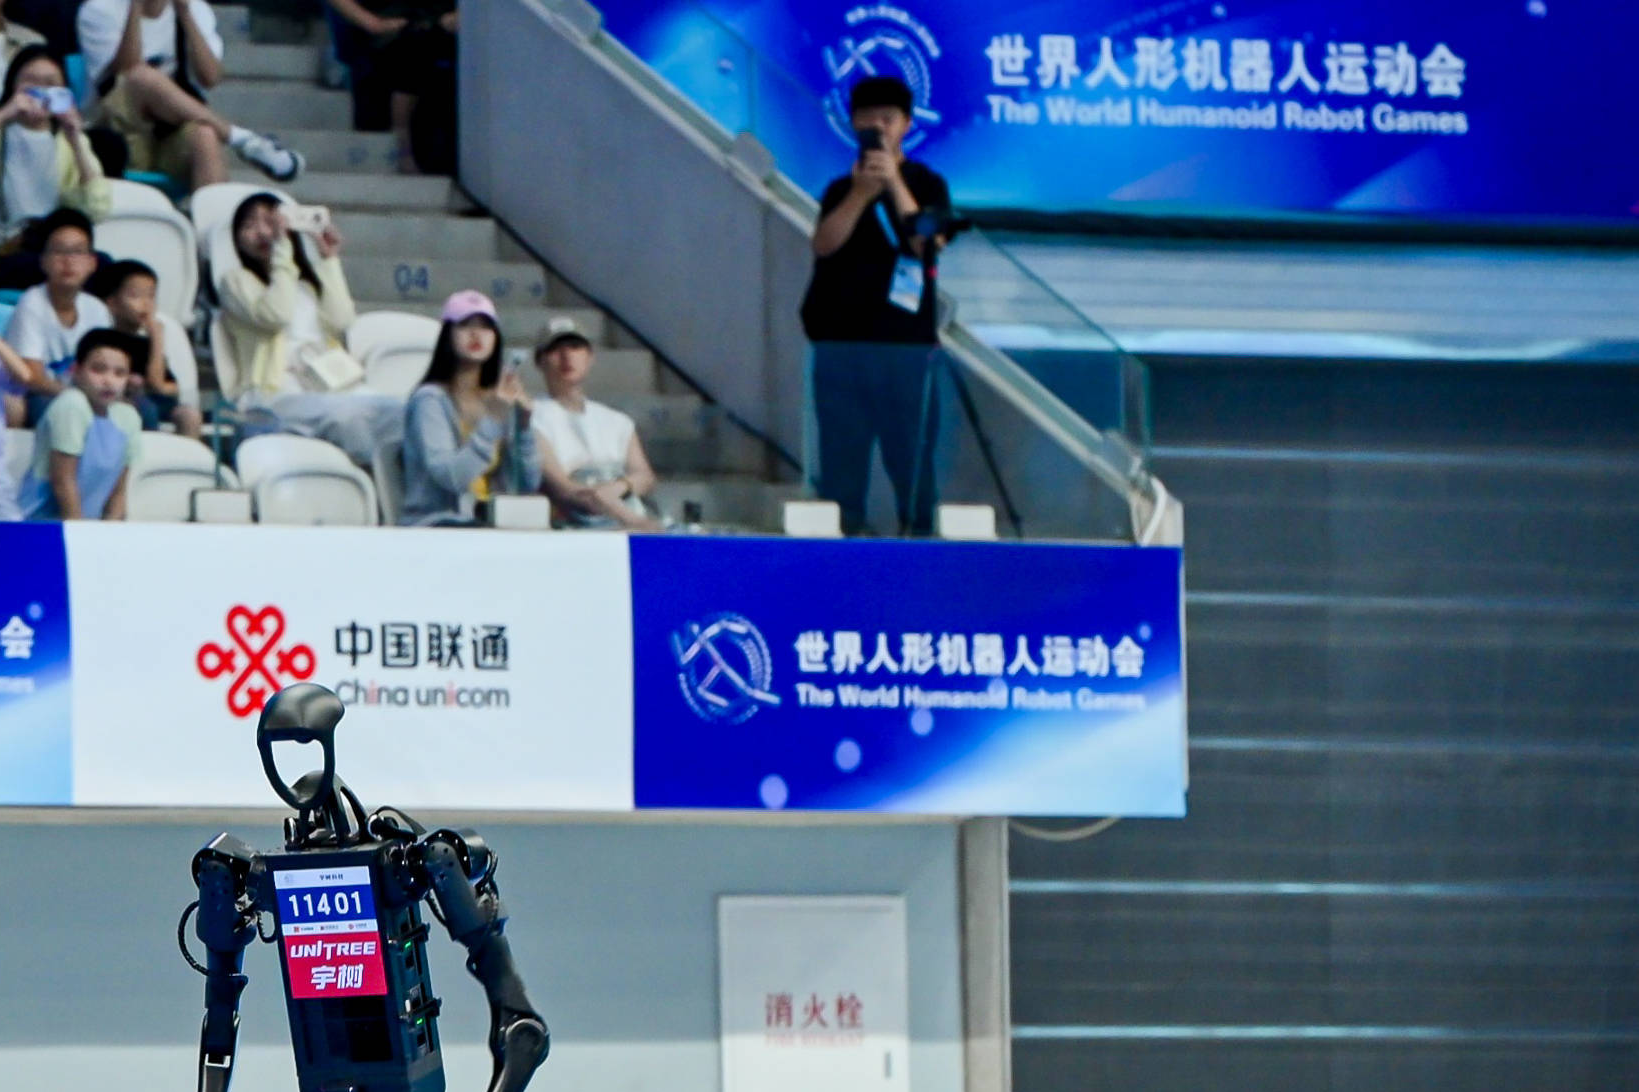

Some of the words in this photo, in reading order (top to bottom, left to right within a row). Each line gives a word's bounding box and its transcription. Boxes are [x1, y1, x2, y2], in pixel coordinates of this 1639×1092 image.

[985, 34, 1466, 98] 世界人形机器人运动会
[988, 94, 1039, 125] The
[1045, 96, 1132, 127] World
[1138, 97, 1278, 130] Humanoid
[1283, 100, 1366, 132] Robot
[1371, 103, 1468, 134] Games
[334, 620, 510, 671] 中国联通
[795, 631, 1145, 678] 世界人形机器人运动会
[336, 679, 409, 706] China
[794, 682, 834, 707] The
[837, 683, 900, 708] World
[904, 684, 1009, 709] Humanoid
[1013, 685, 1072, 709] Robot
[1076, 687, 1147, 710] Games
[288, 890, 362, 918] 11401
[311, 963, 365, 991] 宇树
[765, 992, 865, 1029] 消火栓
